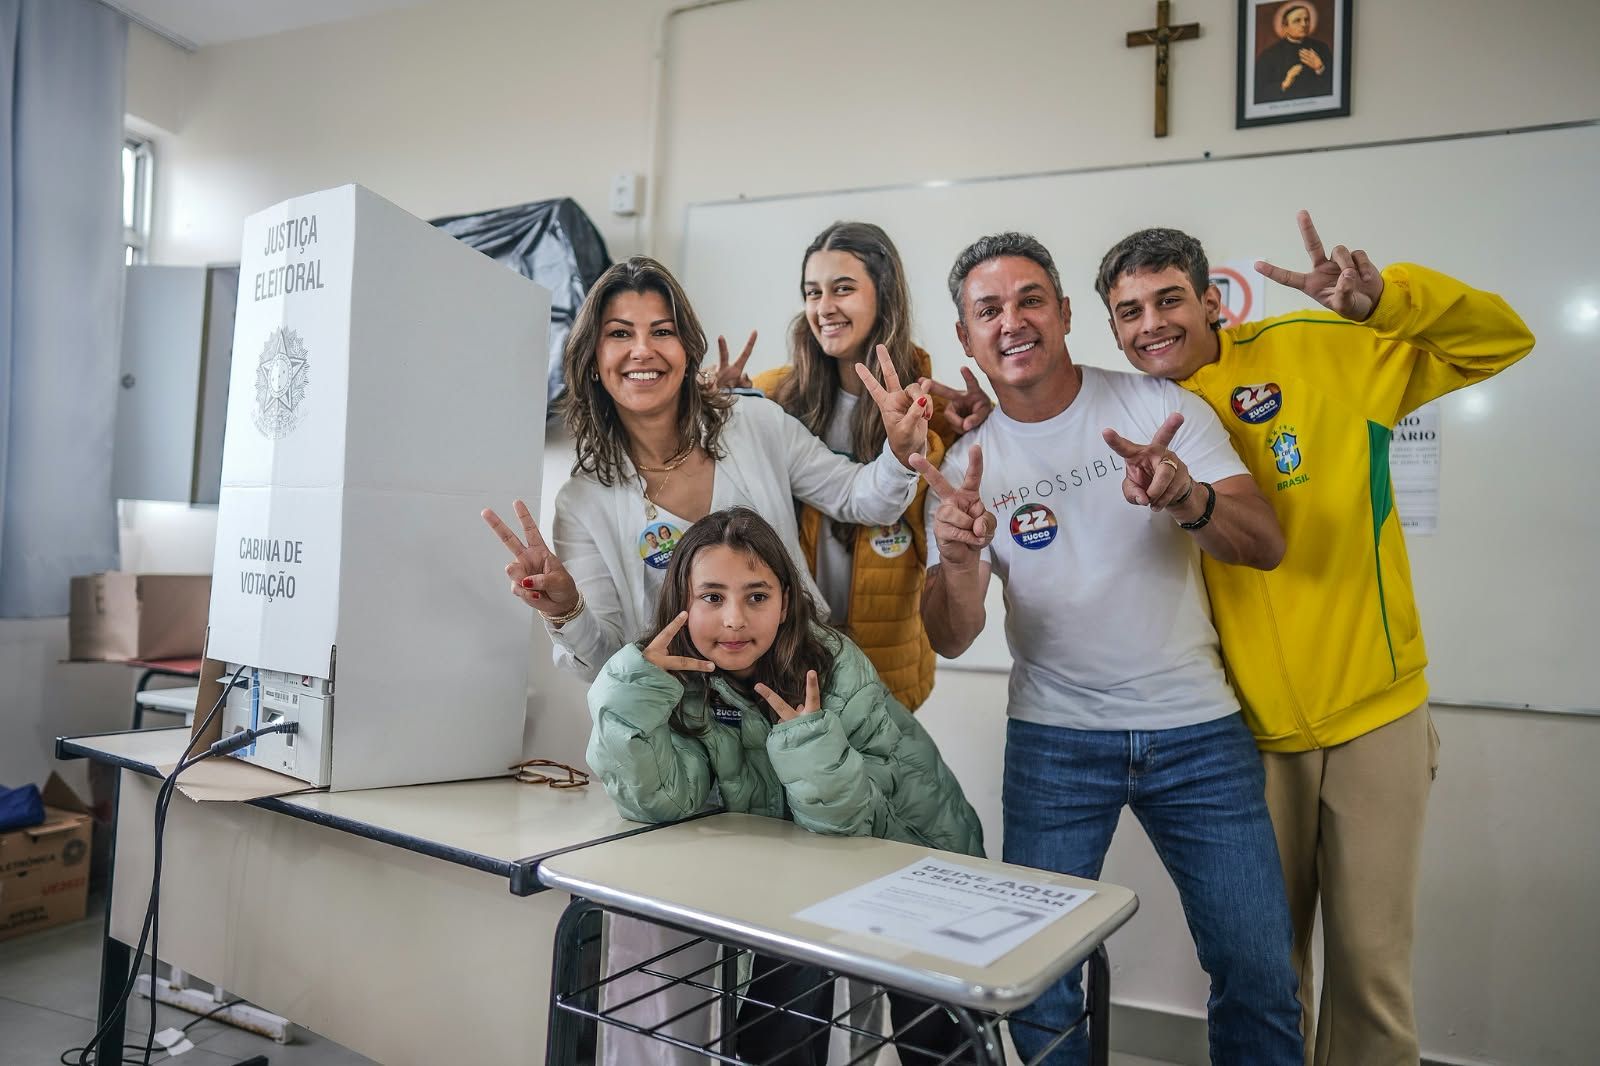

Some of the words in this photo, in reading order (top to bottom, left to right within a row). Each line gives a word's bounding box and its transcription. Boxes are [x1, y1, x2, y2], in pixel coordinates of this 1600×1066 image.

[264, 214, 318, 256] JUSTIÇA
[254, 259, 325, 301] ELEITORAL
[1248, 399, 1276, 419] ZUCCO
[992, 455, 1123, 514] IMPOSSIBL
[1277, 473, 1310, 491] BRASIL
[1016, 509, 1050, 532] 22
[239, 536, 280, 563] CABINA
[284, 540, 303, 564] DE
[1022, 530, 1050, 542] ZUCCO
[654, 550, 674, 563] ZUCC
[240, 570, 297, 602] VOTAÇÃO
[922, 864, 994, 883] DEIXE
[994, 880, 1078, 901] AQUI
[930, 875, 970, 886] SEU
[973, 884, 1066, 907] CELULAR
